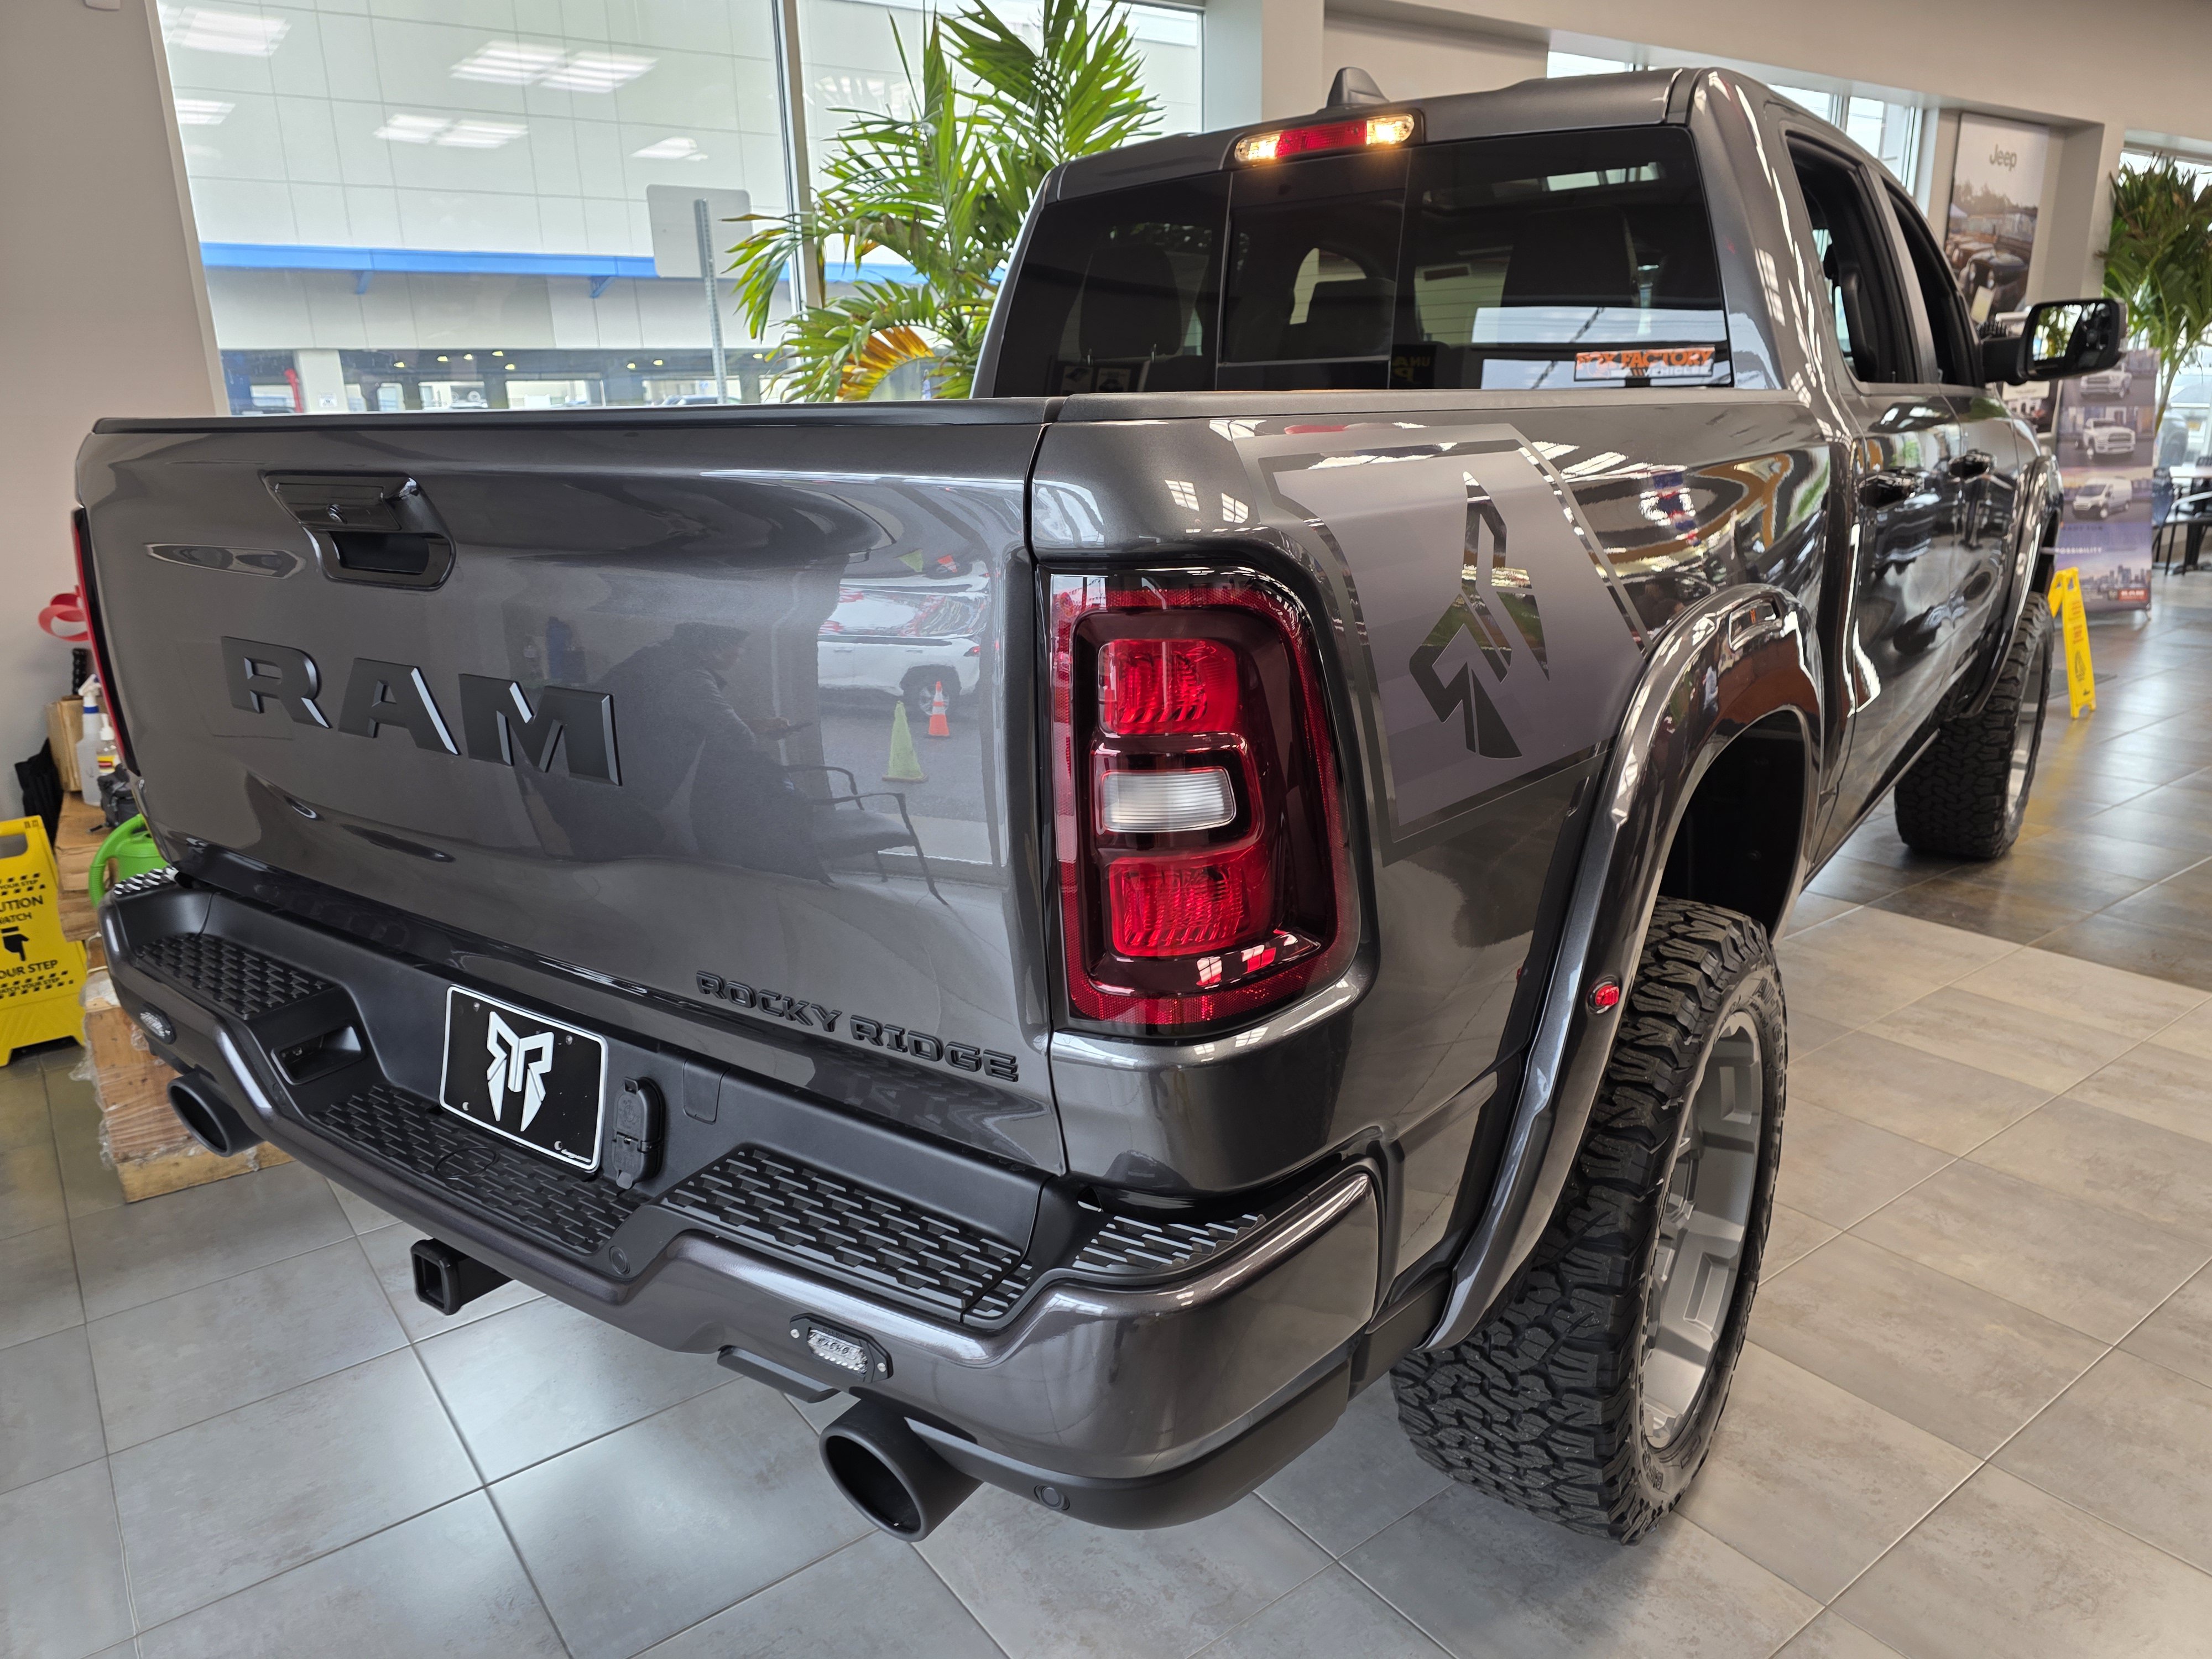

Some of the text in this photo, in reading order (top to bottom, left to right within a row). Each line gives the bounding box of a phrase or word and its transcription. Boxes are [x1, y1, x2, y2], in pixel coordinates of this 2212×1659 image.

[1989, 143, 2017, 171] Jeep
[1576, 350, 1713, 372] FOX FACTORY
[1644, 366, 1710, 377] VEHICLES
[221, 635, 623, 786] RAM
[28, 959, 58, 973] STEP
[696, 969, 1019, 1082] ROCKY RIDGE
